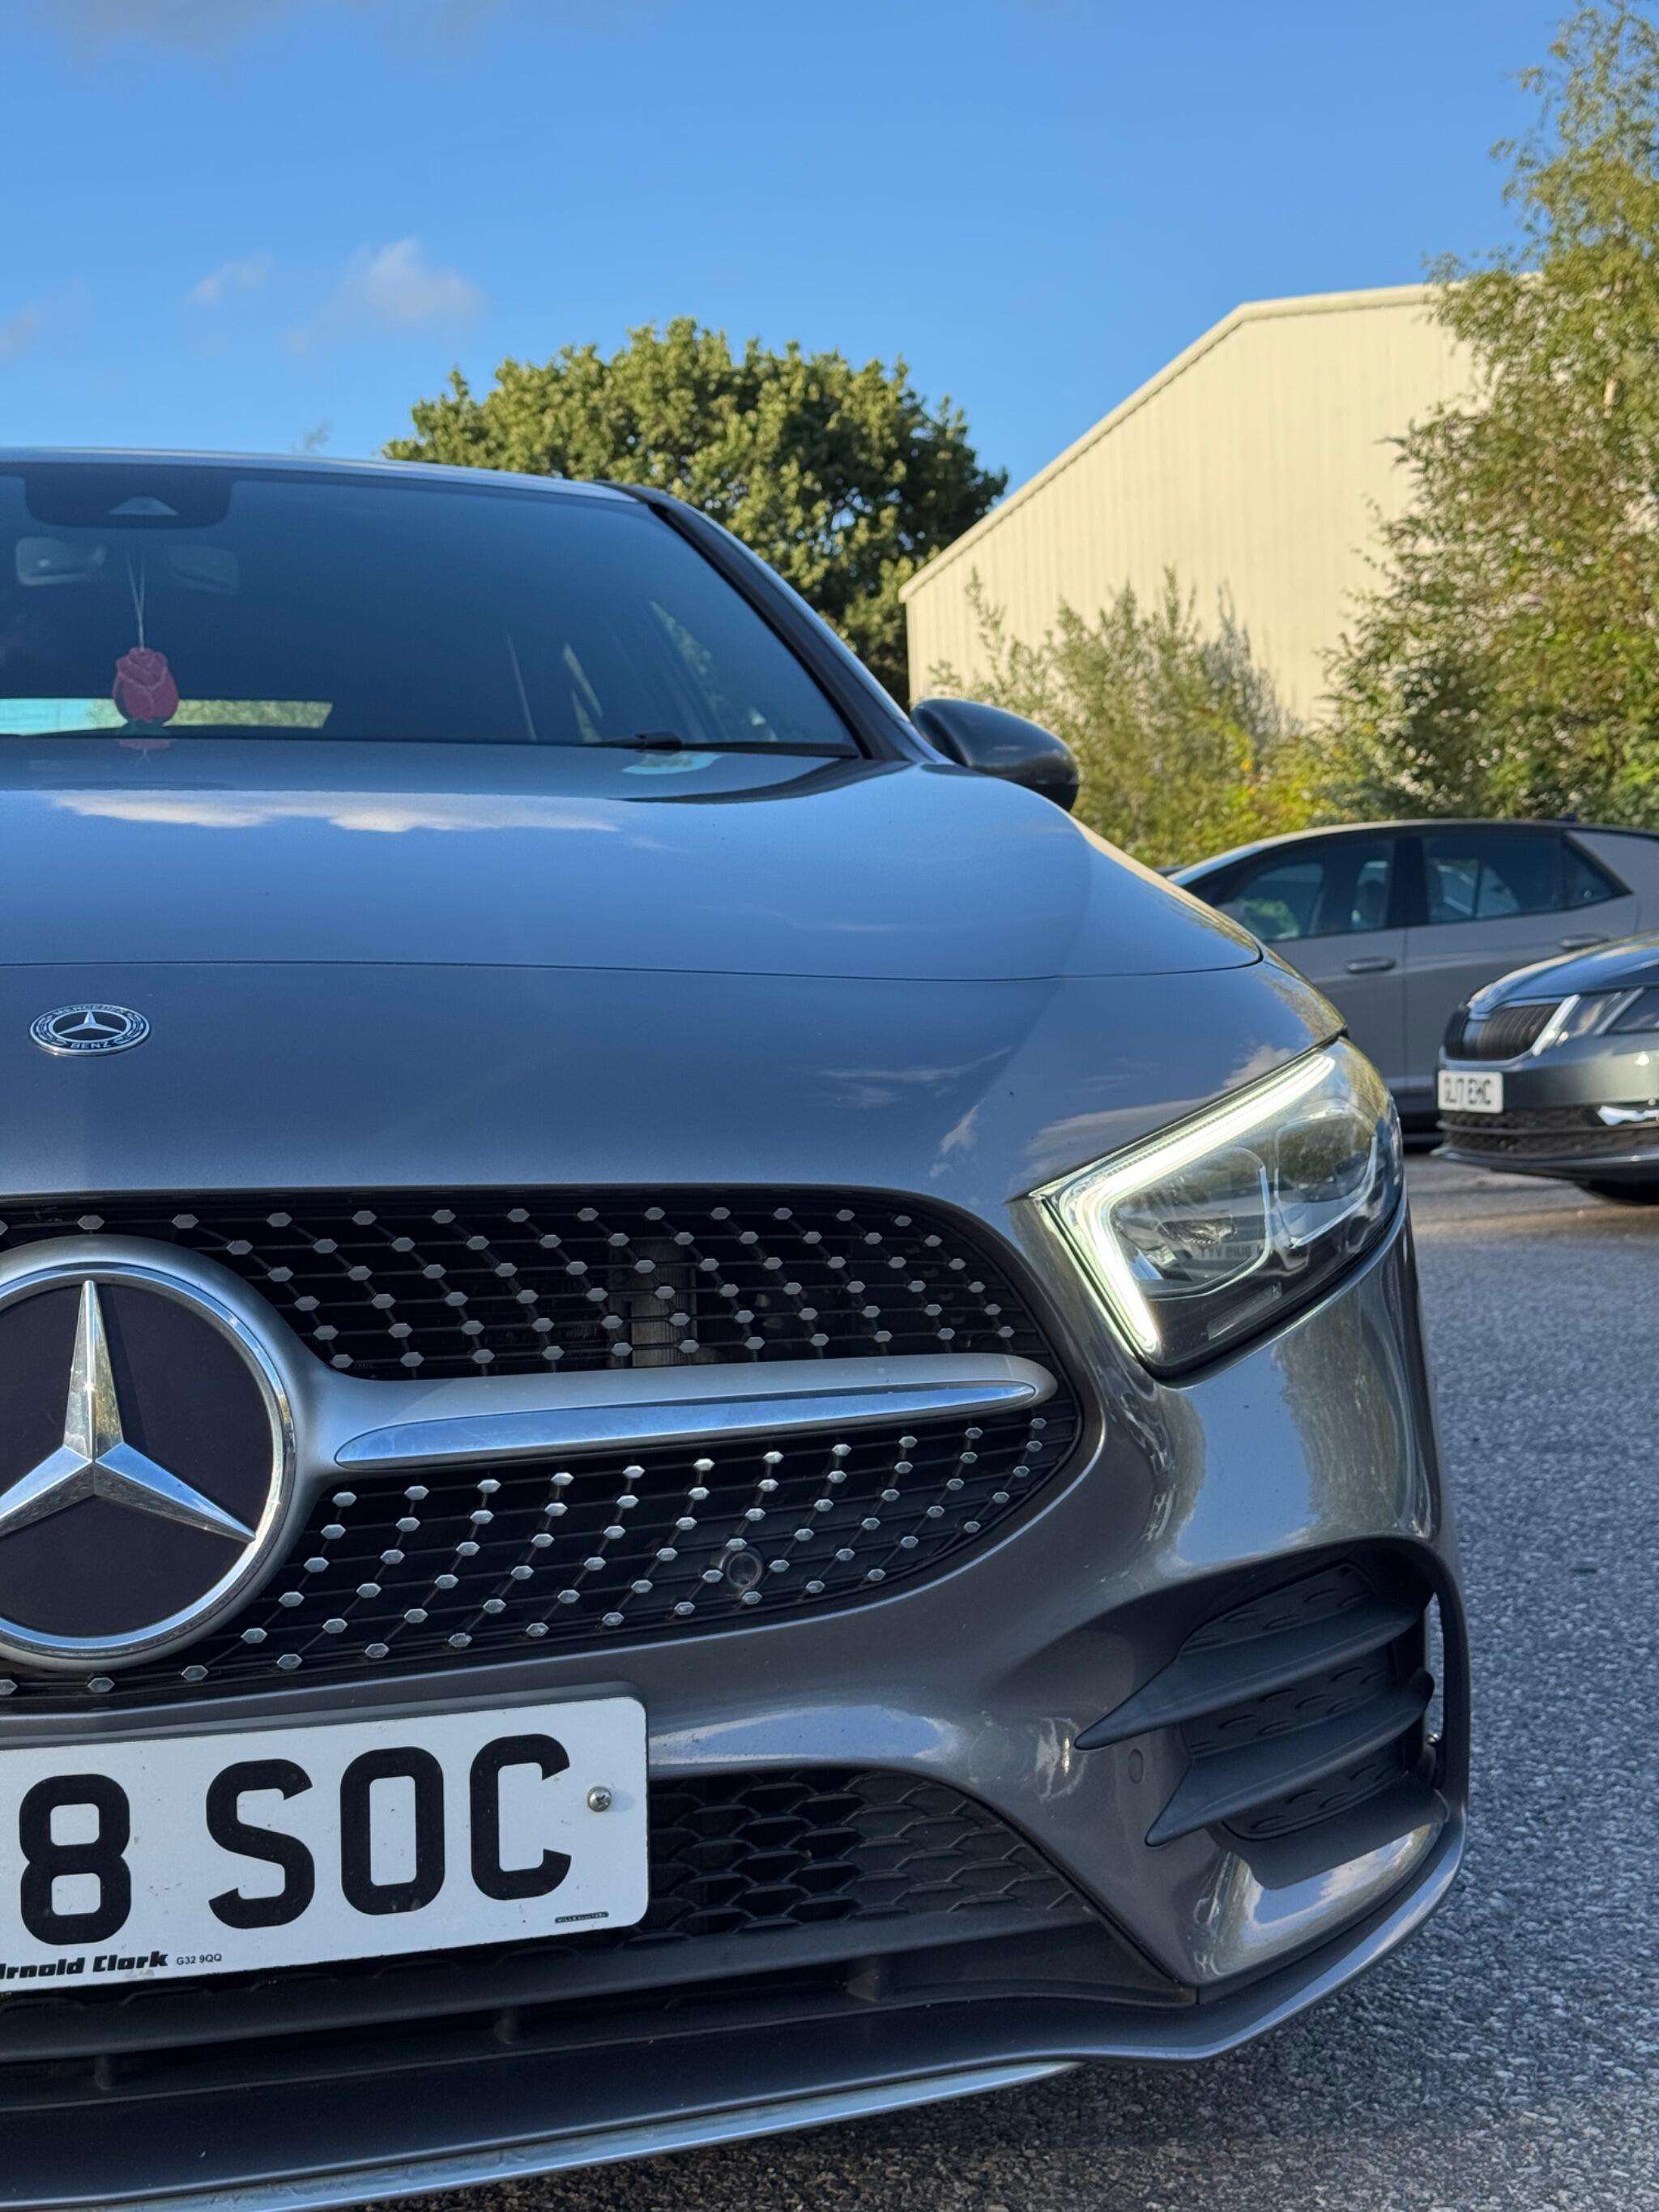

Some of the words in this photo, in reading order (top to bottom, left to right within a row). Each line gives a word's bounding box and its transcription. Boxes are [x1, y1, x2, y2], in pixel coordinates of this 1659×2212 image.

[19, 1773, 131, 1945] 8
[206, 1733, 572, 1930] SOC
[92, 1950, 168, 1973] Clark
[176, 1955, 196, 1966] G32
[199, 1953, 222, 1963] 9QQ
